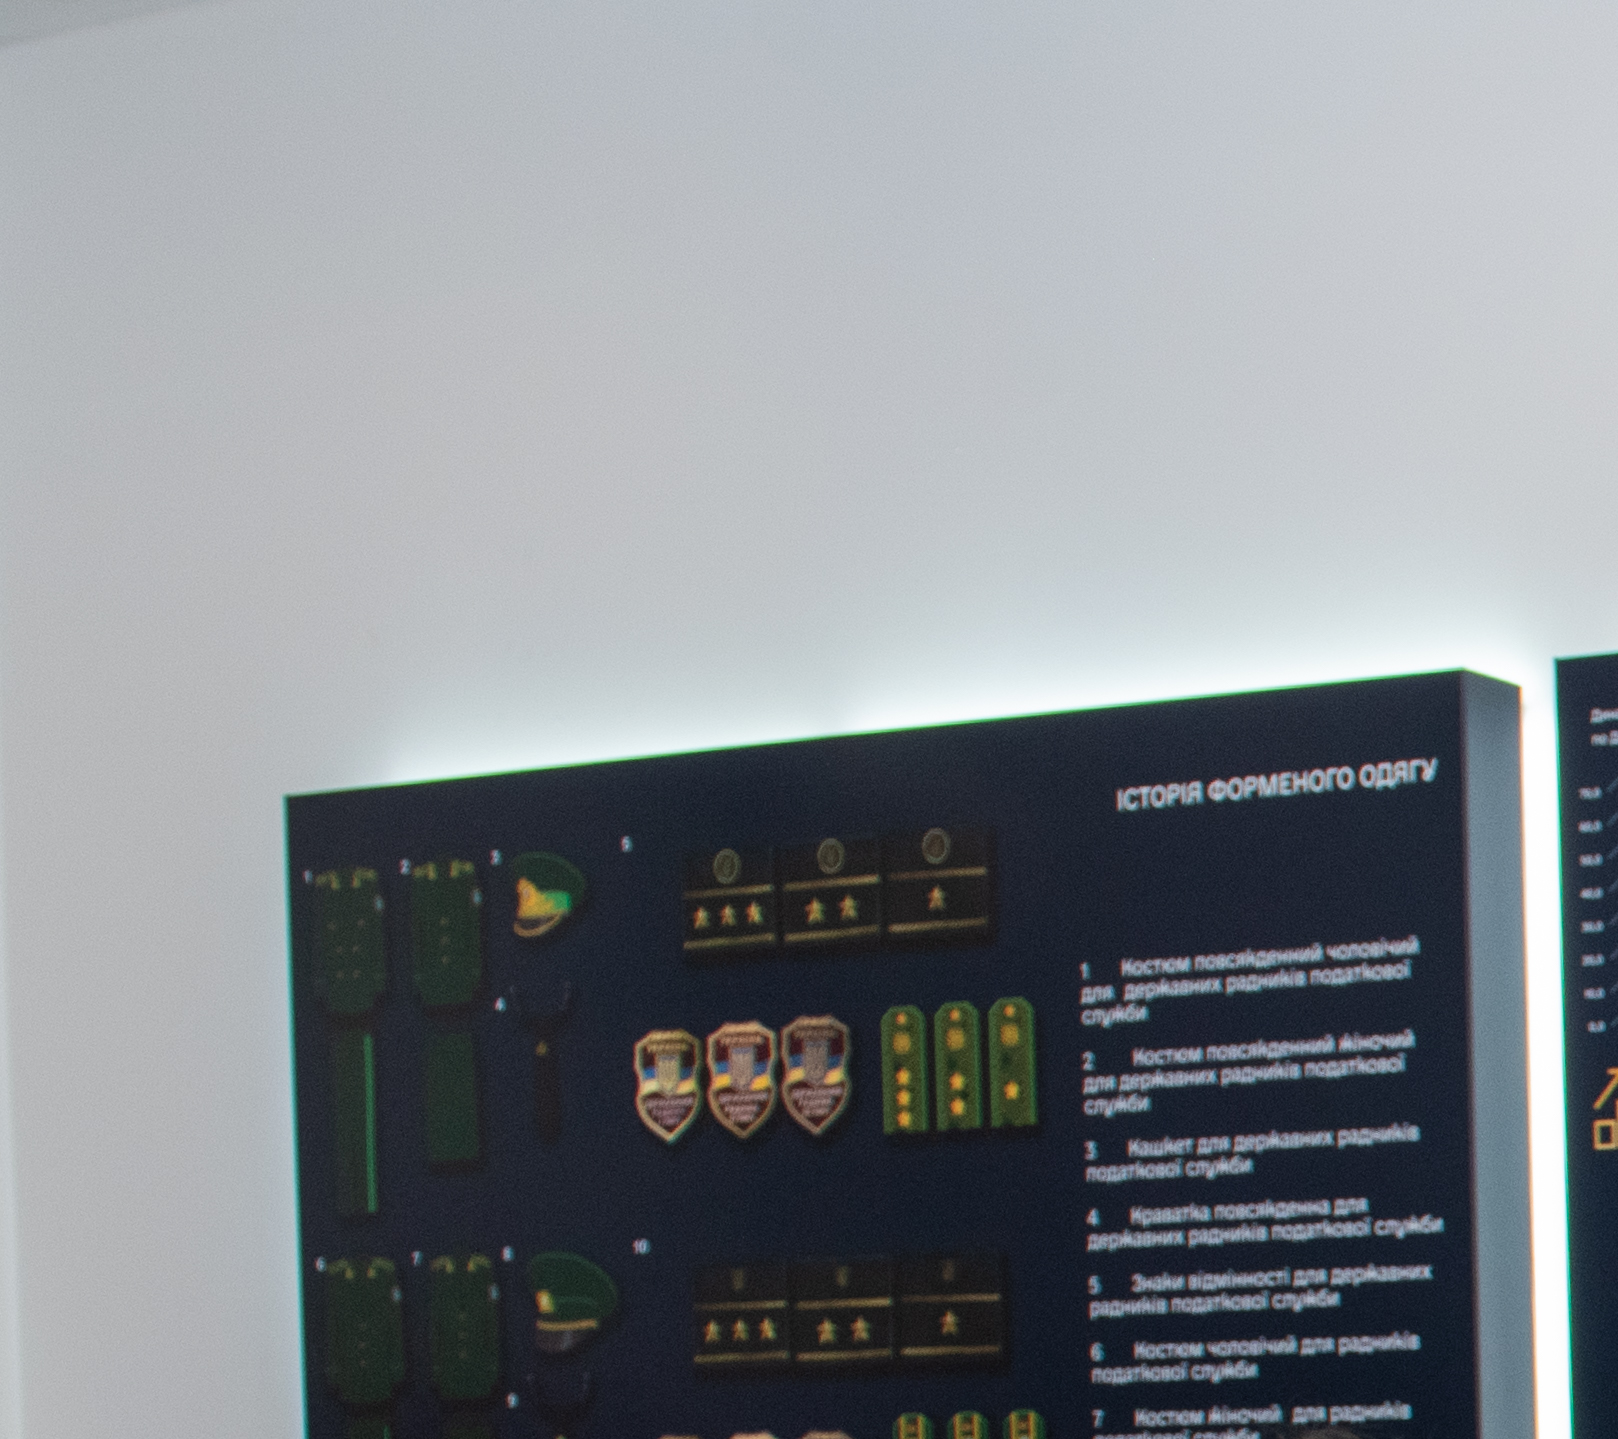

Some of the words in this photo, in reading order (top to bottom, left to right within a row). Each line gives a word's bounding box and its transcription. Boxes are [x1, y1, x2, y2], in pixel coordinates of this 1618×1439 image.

[1117, 780, 1203, 811] ІСТОРІЯ
[1207, 765, 1355, 802] ФОРМЕНОГО
[1359, 757, 1438, 790] ОДЯГУ
